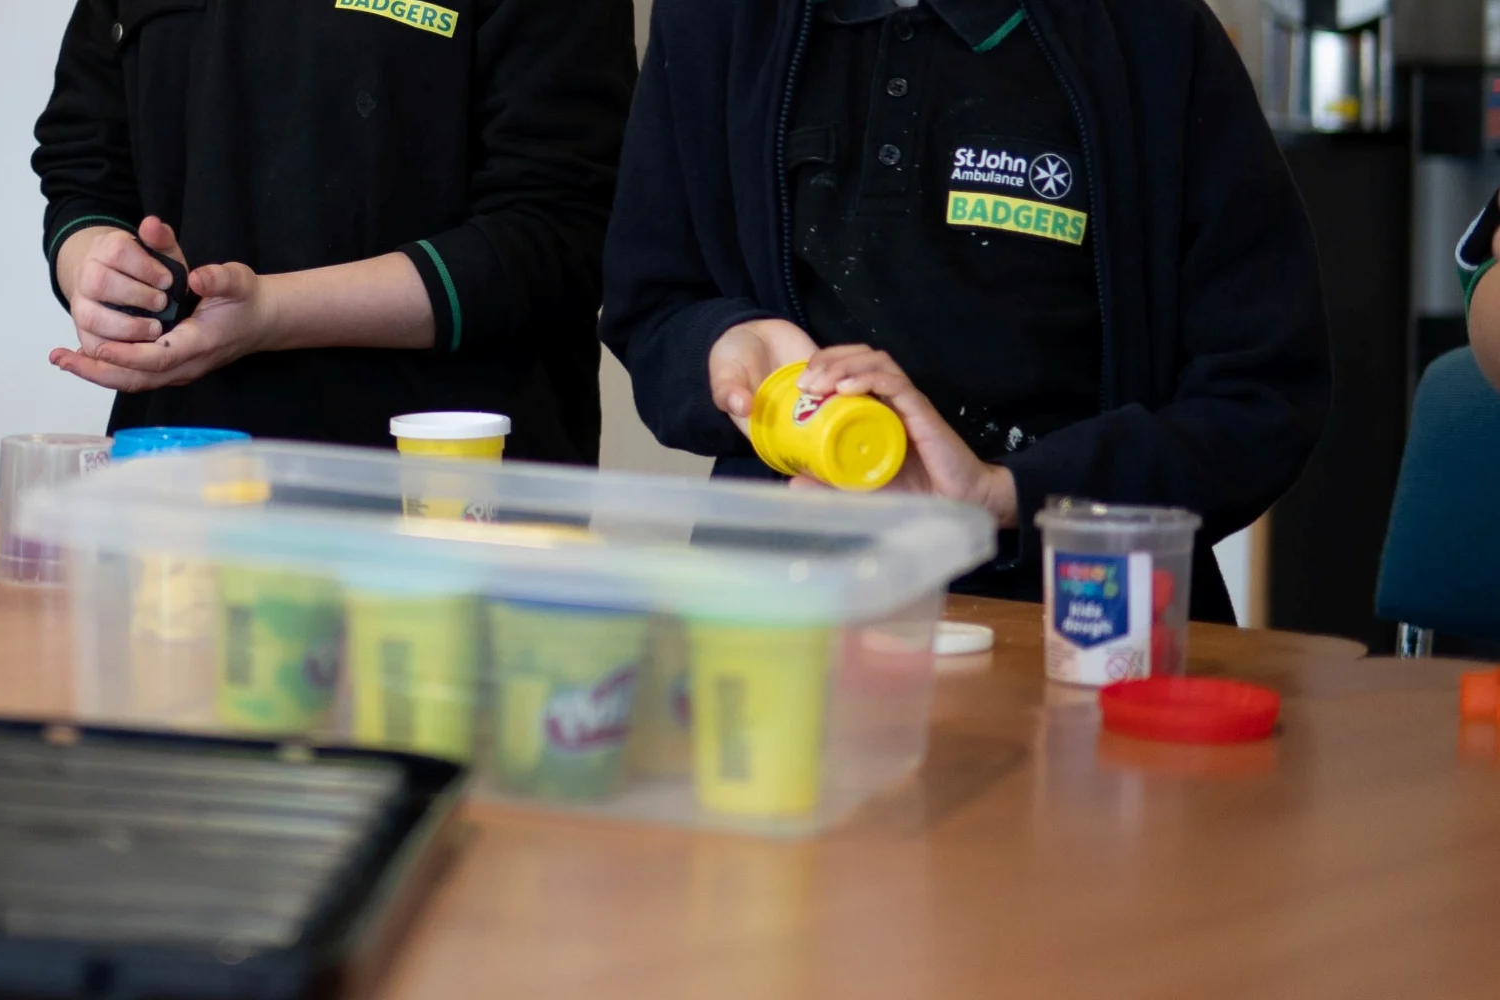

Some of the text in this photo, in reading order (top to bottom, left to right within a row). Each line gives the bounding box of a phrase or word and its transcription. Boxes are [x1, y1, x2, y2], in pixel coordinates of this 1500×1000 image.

[953, 148, 1027, 173] St John
[951, 167, 1025, 187] Ambulance
[951, 196, 1084, 241] BADGERS
